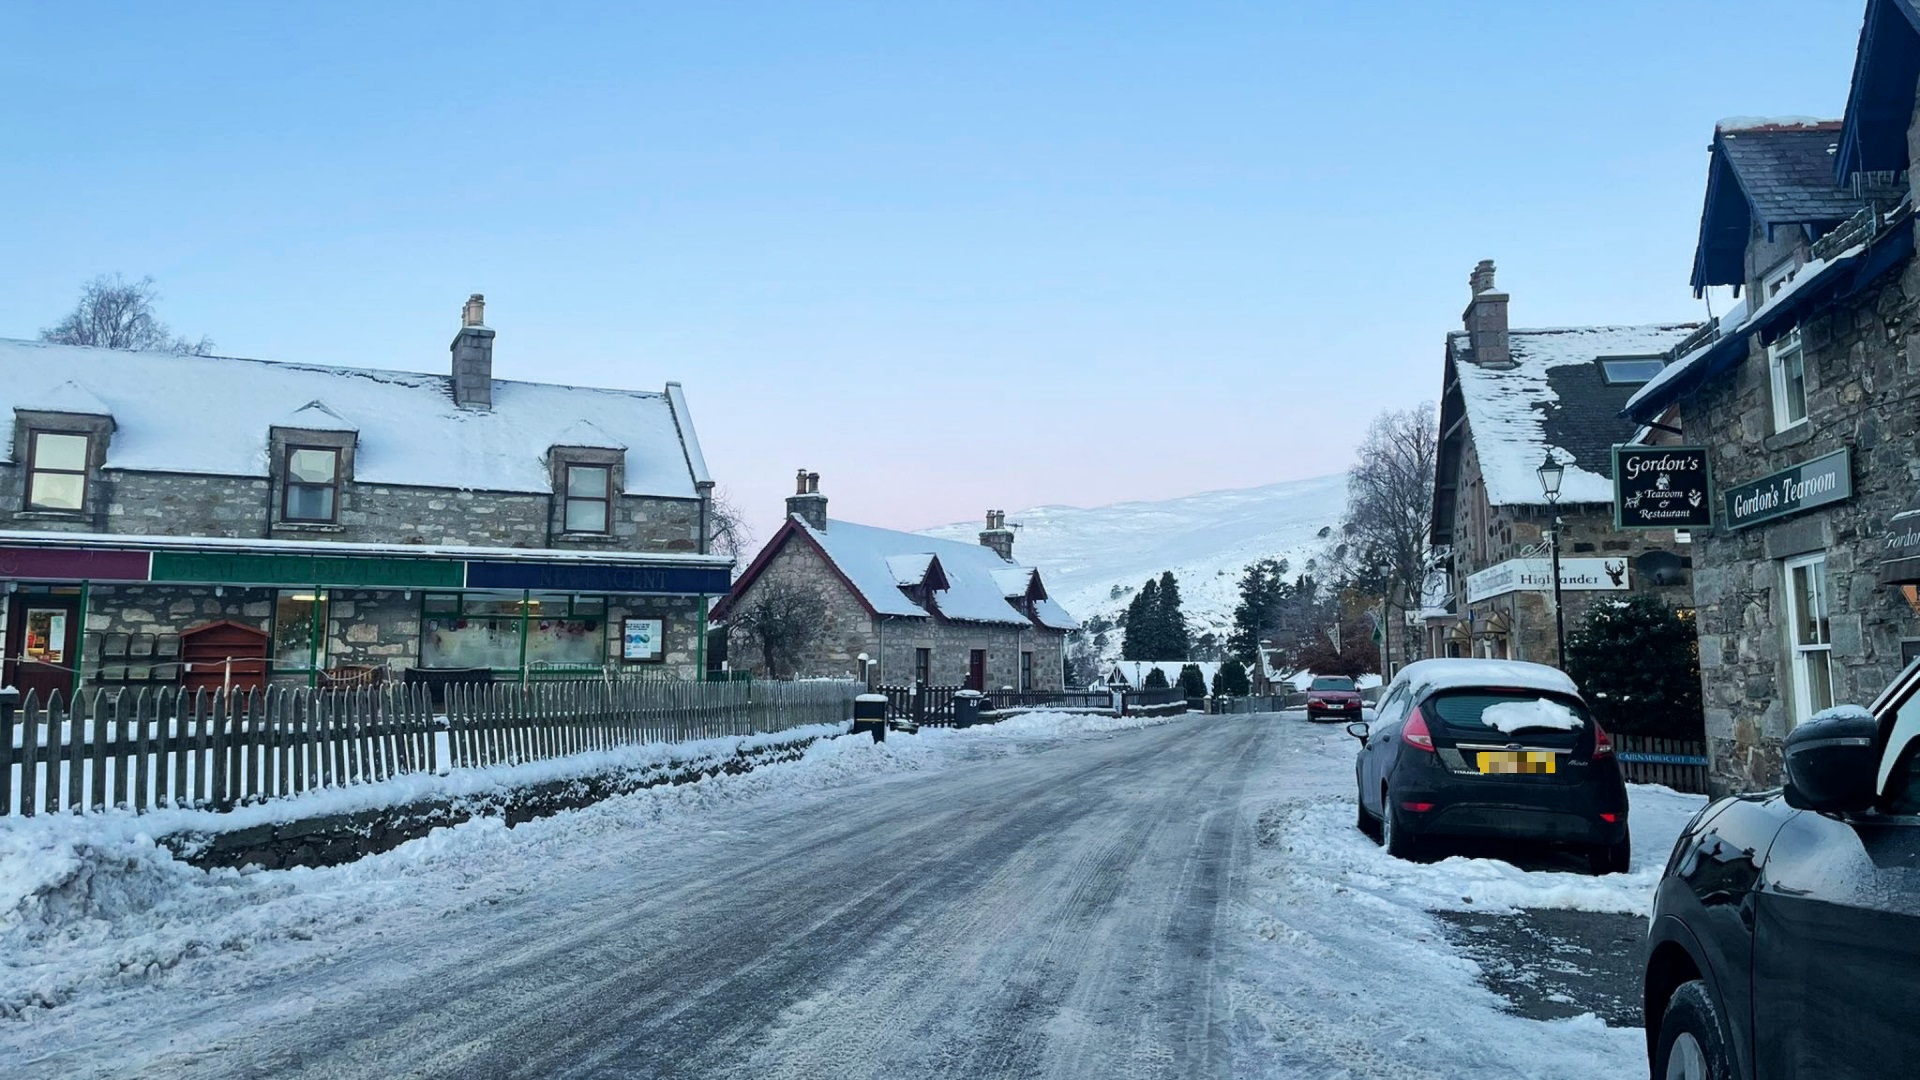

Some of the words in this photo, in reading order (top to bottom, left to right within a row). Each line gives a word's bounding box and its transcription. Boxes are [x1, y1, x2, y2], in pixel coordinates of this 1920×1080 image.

[1626, 454, 1699, 480] Gordon's
[1644, 489, 1684, 499] Tearoom
[1734, 484, 1779, 519] Gordon's
[1782, 471, 1836, 504] Tearoom
[1659, 499, 1671, 508] &
[1639, 509, 1691, 520] Restaurant
[1520, 574, 1598, 588] Highander
